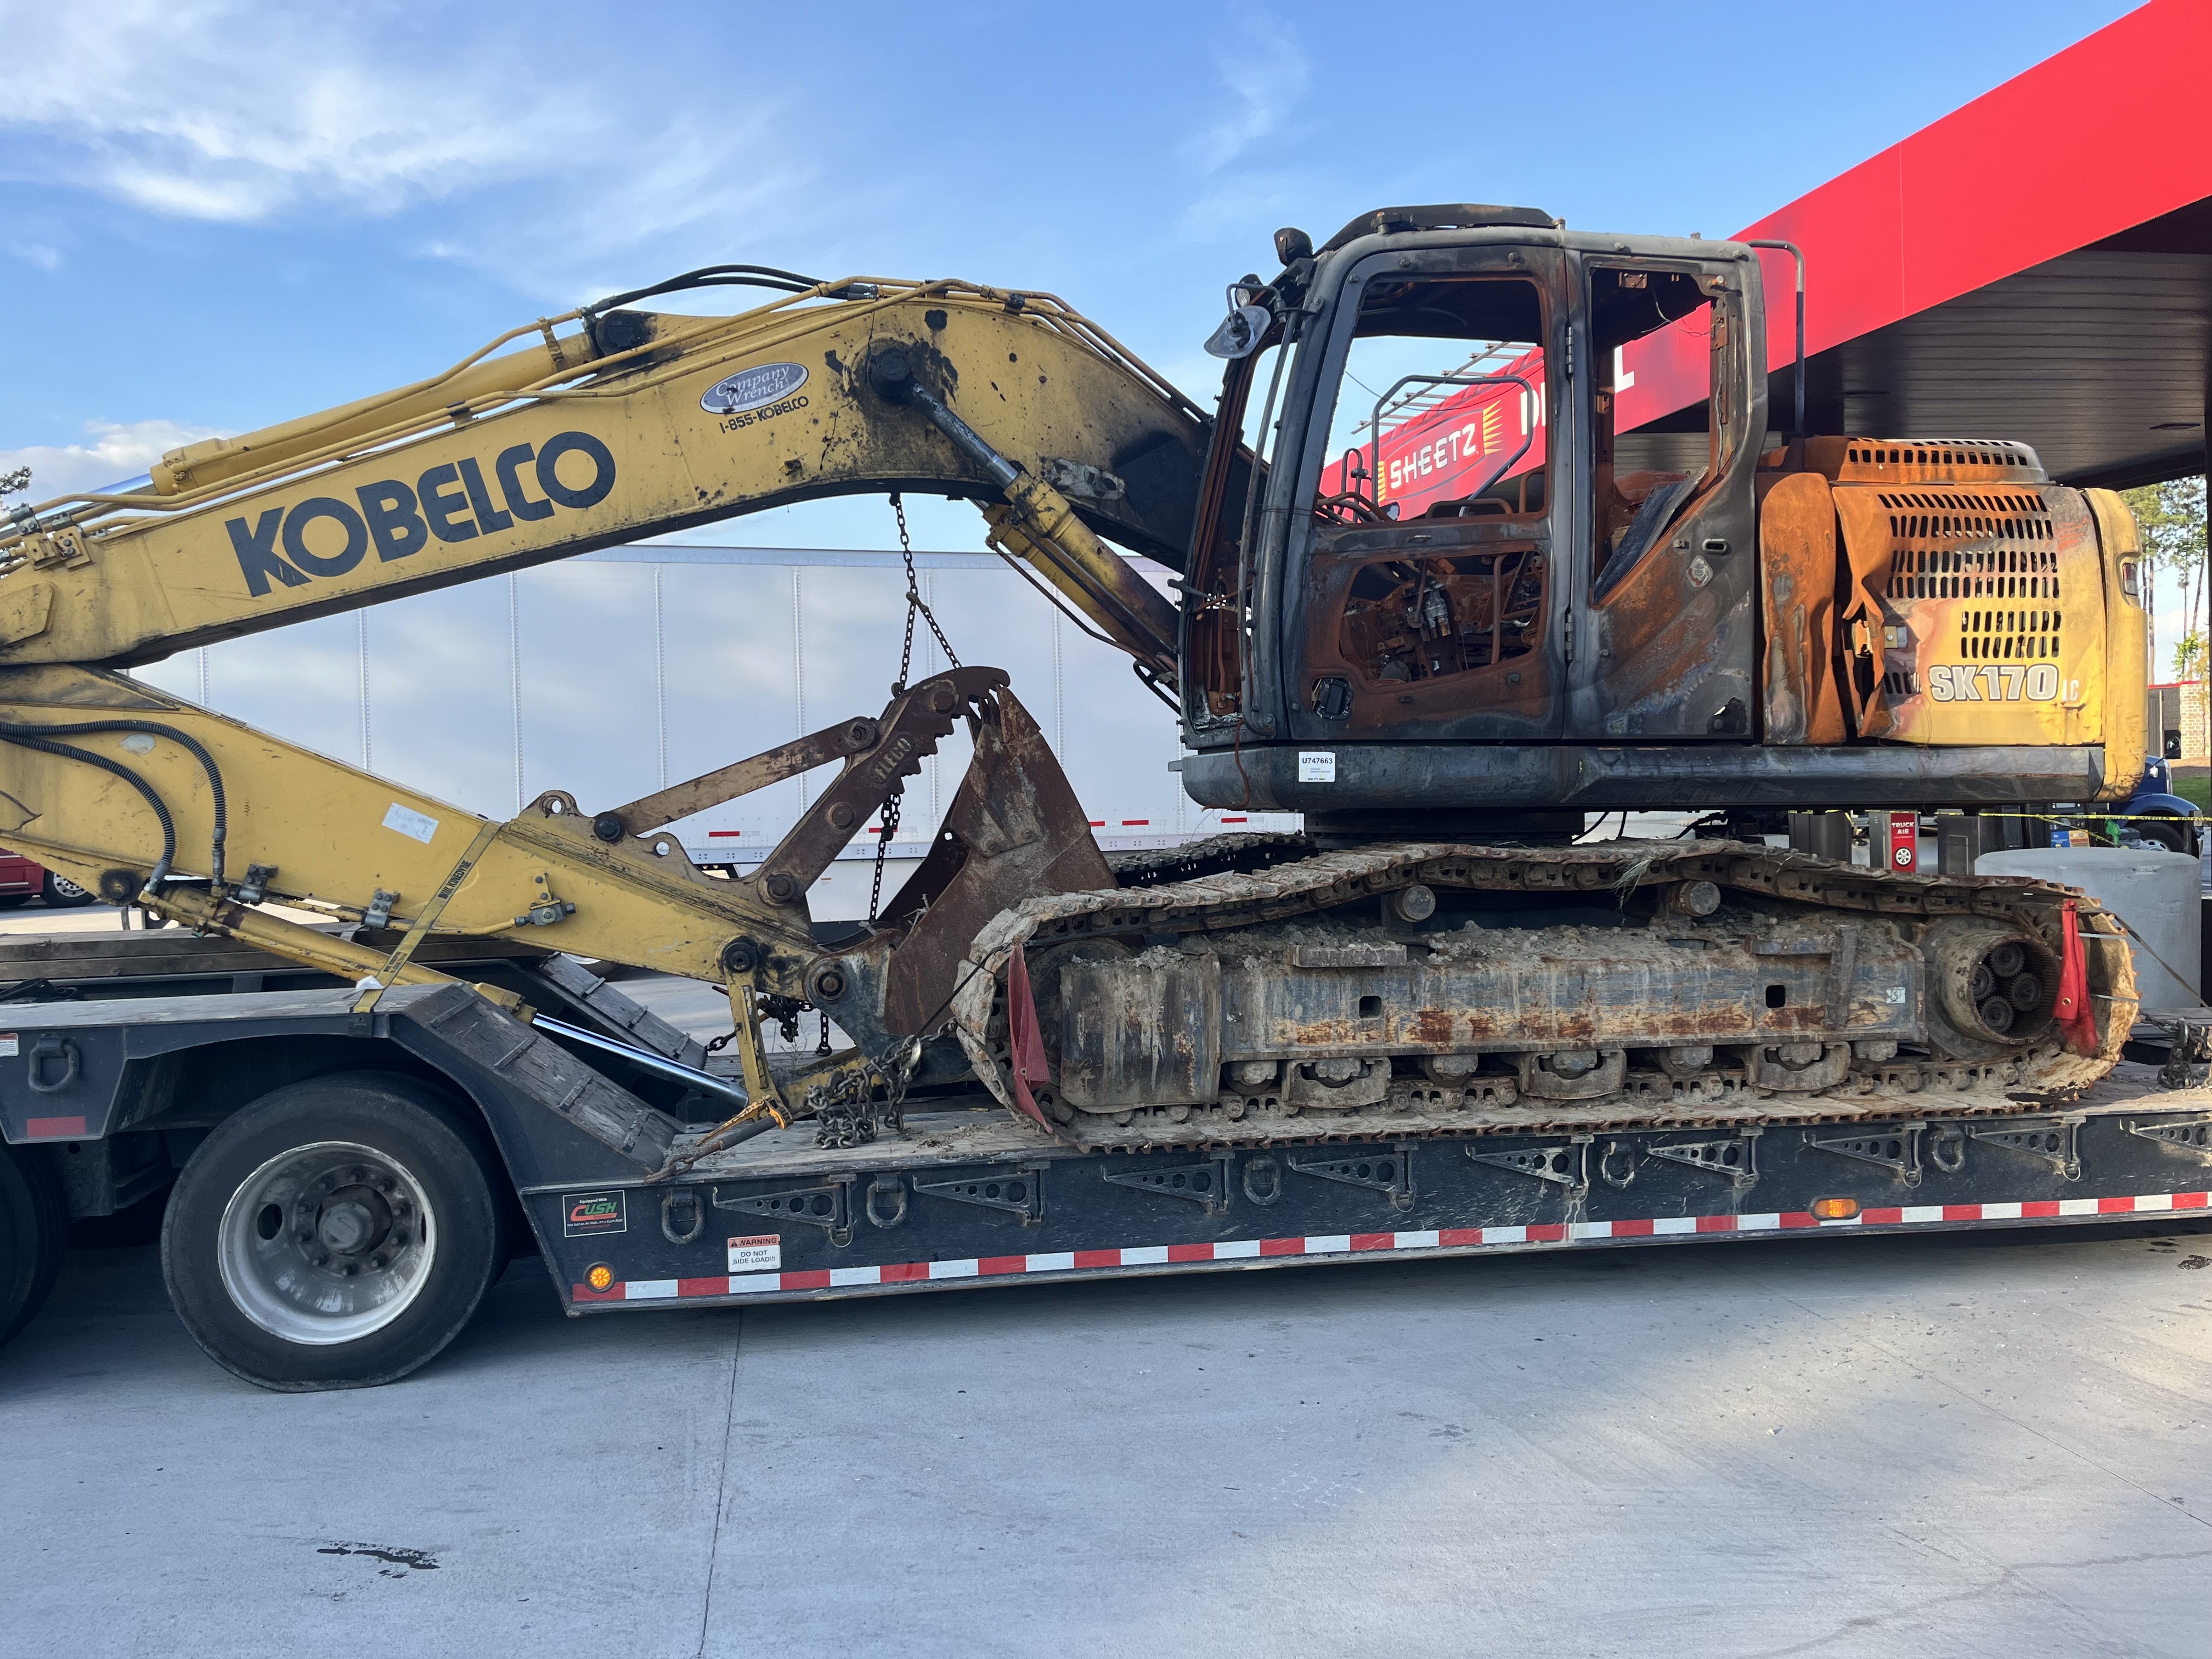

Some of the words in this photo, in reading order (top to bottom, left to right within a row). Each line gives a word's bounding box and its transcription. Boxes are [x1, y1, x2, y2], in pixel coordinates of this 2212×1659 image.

[716, 366, 789, 397] Company
[725, 379, 785, 406] Wrench
[719, 396, 809, 434] 1-855-KOBELCO
[1390, 423, 1476, 489] SHEETZ
[225, 431, 616, 597] KOBELCO
[1928, 663, 2059, 702] SK170
[874, 737, 911, 780] FLECO
[446, 860, 472, 888] KINEDYNE
[571, 1201, 618, 1222] CUSH
[739, 1238, 777, 1246] WARNING
